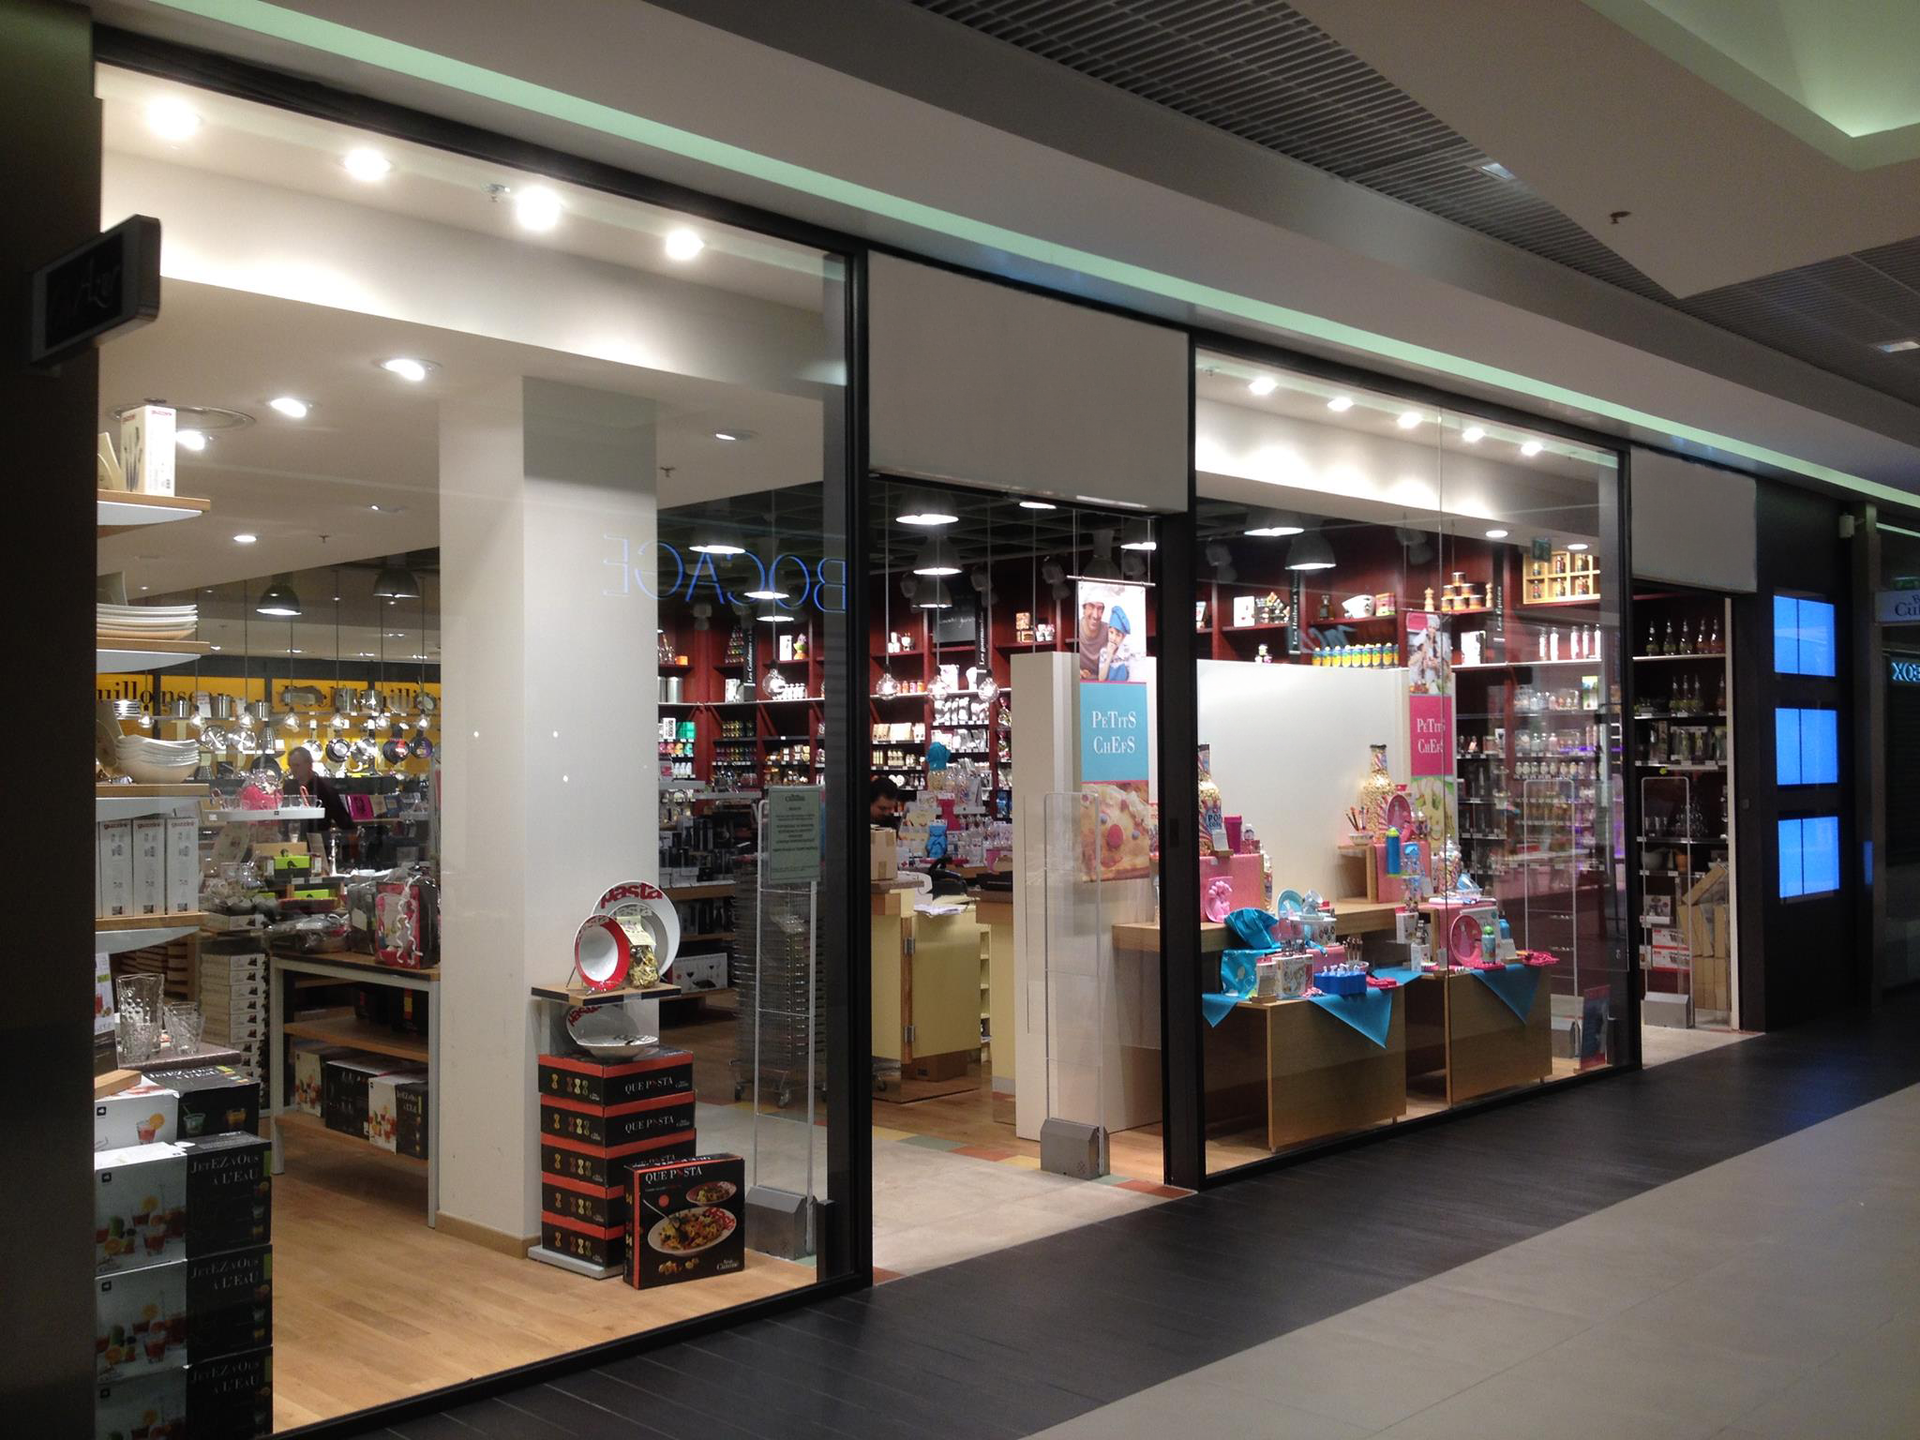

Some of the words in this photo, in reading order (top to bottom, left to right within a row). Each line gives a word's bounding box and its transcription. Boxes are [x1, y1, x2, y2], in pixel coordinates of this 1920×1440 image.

[1092, 710, 1137, 729] PETITS
[1093, 735, 1136, 755] CHEFS
[600, 882, 663, 909] pasta
[625, 1082, 645, 1095] QUE
[625, 1119, 645, 1134] QUE
[645, 1170, 668, 1185] QUE
